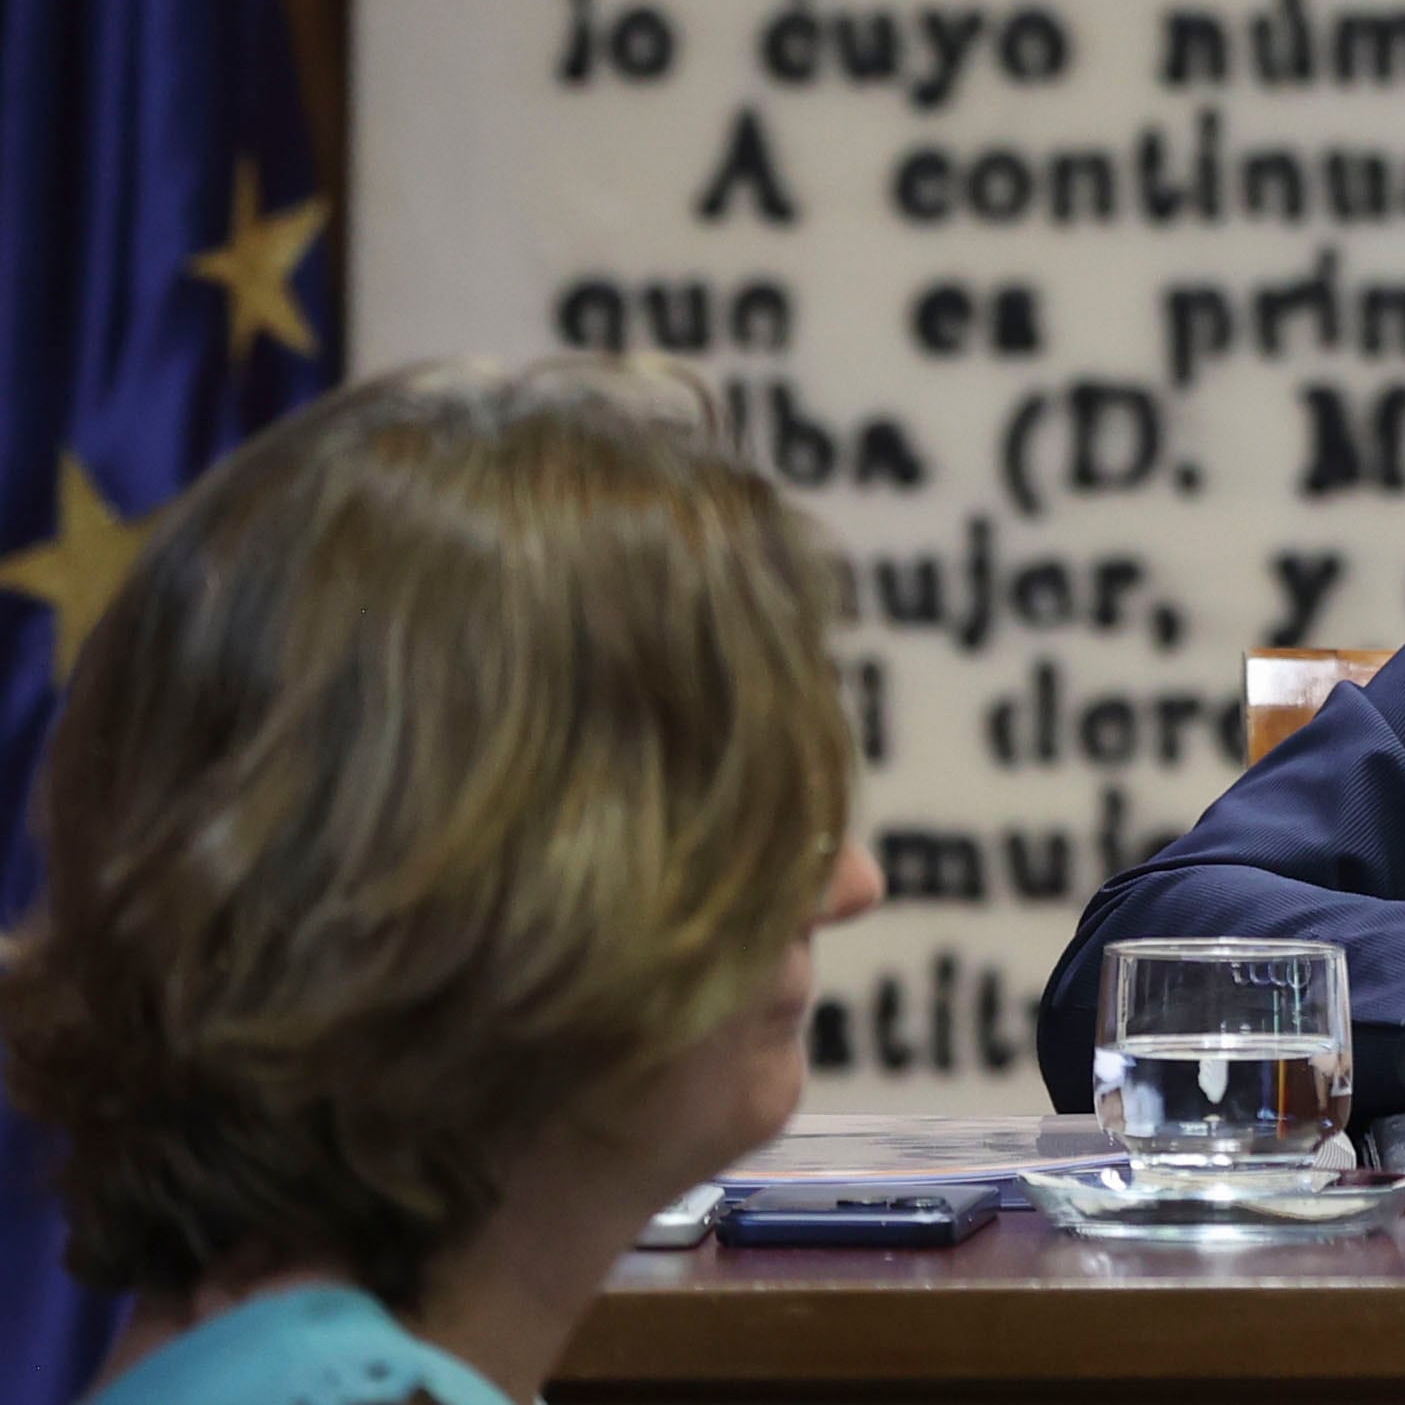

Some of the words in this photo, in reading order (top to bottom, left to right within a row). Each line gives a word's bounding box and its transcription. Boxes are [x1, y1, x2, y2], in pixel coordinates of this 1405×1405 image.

[758, 0, 1072, 114] cuyo
[696, 108, 797, 226] A
[555, 279, 791, 359] que
[911, 283, 1041, 357] es
[1265, 553, 1344, 648] y
